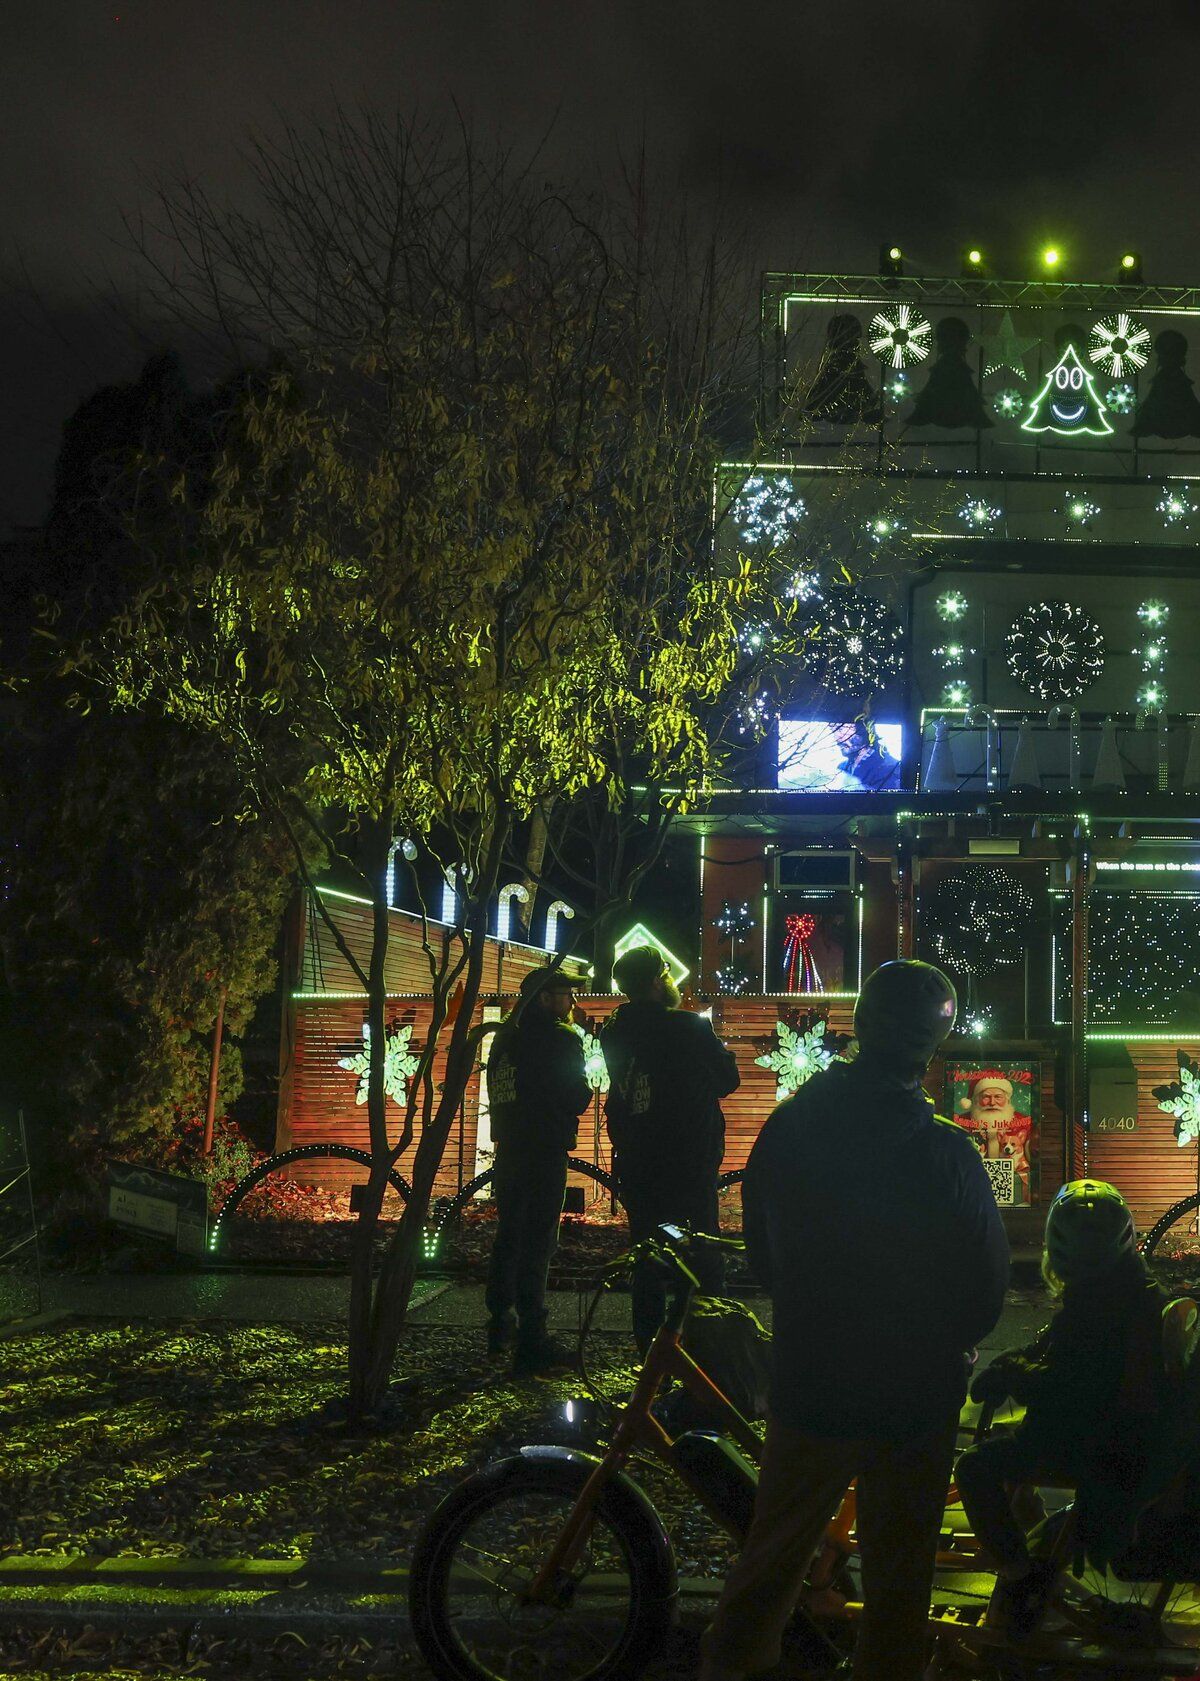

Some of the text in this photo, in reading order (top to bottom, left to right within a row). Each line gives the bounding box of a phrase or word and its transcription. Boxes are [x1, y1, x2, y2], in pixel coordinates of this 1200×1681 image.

[1096, 862, 1119, 870] When
[1120, 862, 1135, 870] the
[1166, 862, 1181, 870] the
[1098, 1117, 1135, 1131] 4040
